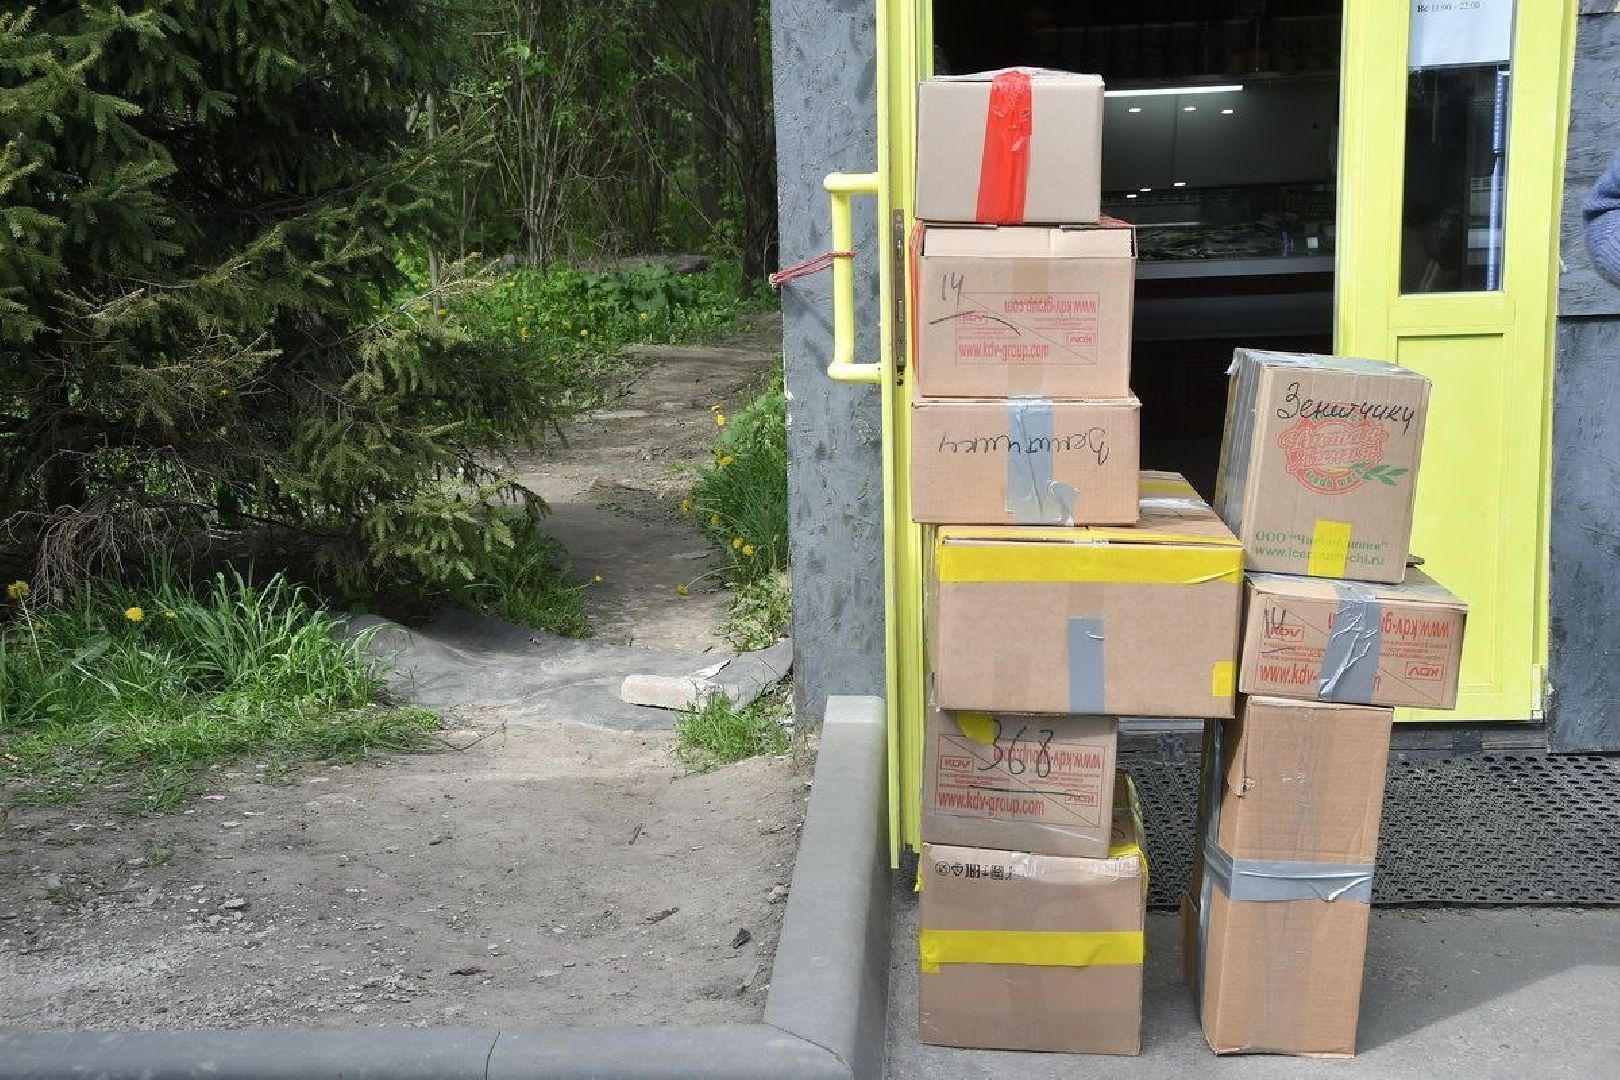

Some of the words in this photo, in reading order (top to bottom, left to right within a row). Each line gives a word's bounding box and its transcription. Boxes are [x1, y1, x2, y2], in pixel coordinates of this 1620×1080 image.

[940, 272, 964, 308] 14
[1004, 297, 1096, 317] www.kdv-group.com
[958, 342, 1049, 362] www.kdv-group.com
[1277, 382, 1416, 435] Зенитчику
[938, 426, 1110, 466] Зенитчику
[1408, 666, 1441, 678] KDV
[978, 719, 1054, 778] 368
[943, 759, 972, 769] KDV
[938, 790, 1045, 815] www.kdv-group.com
